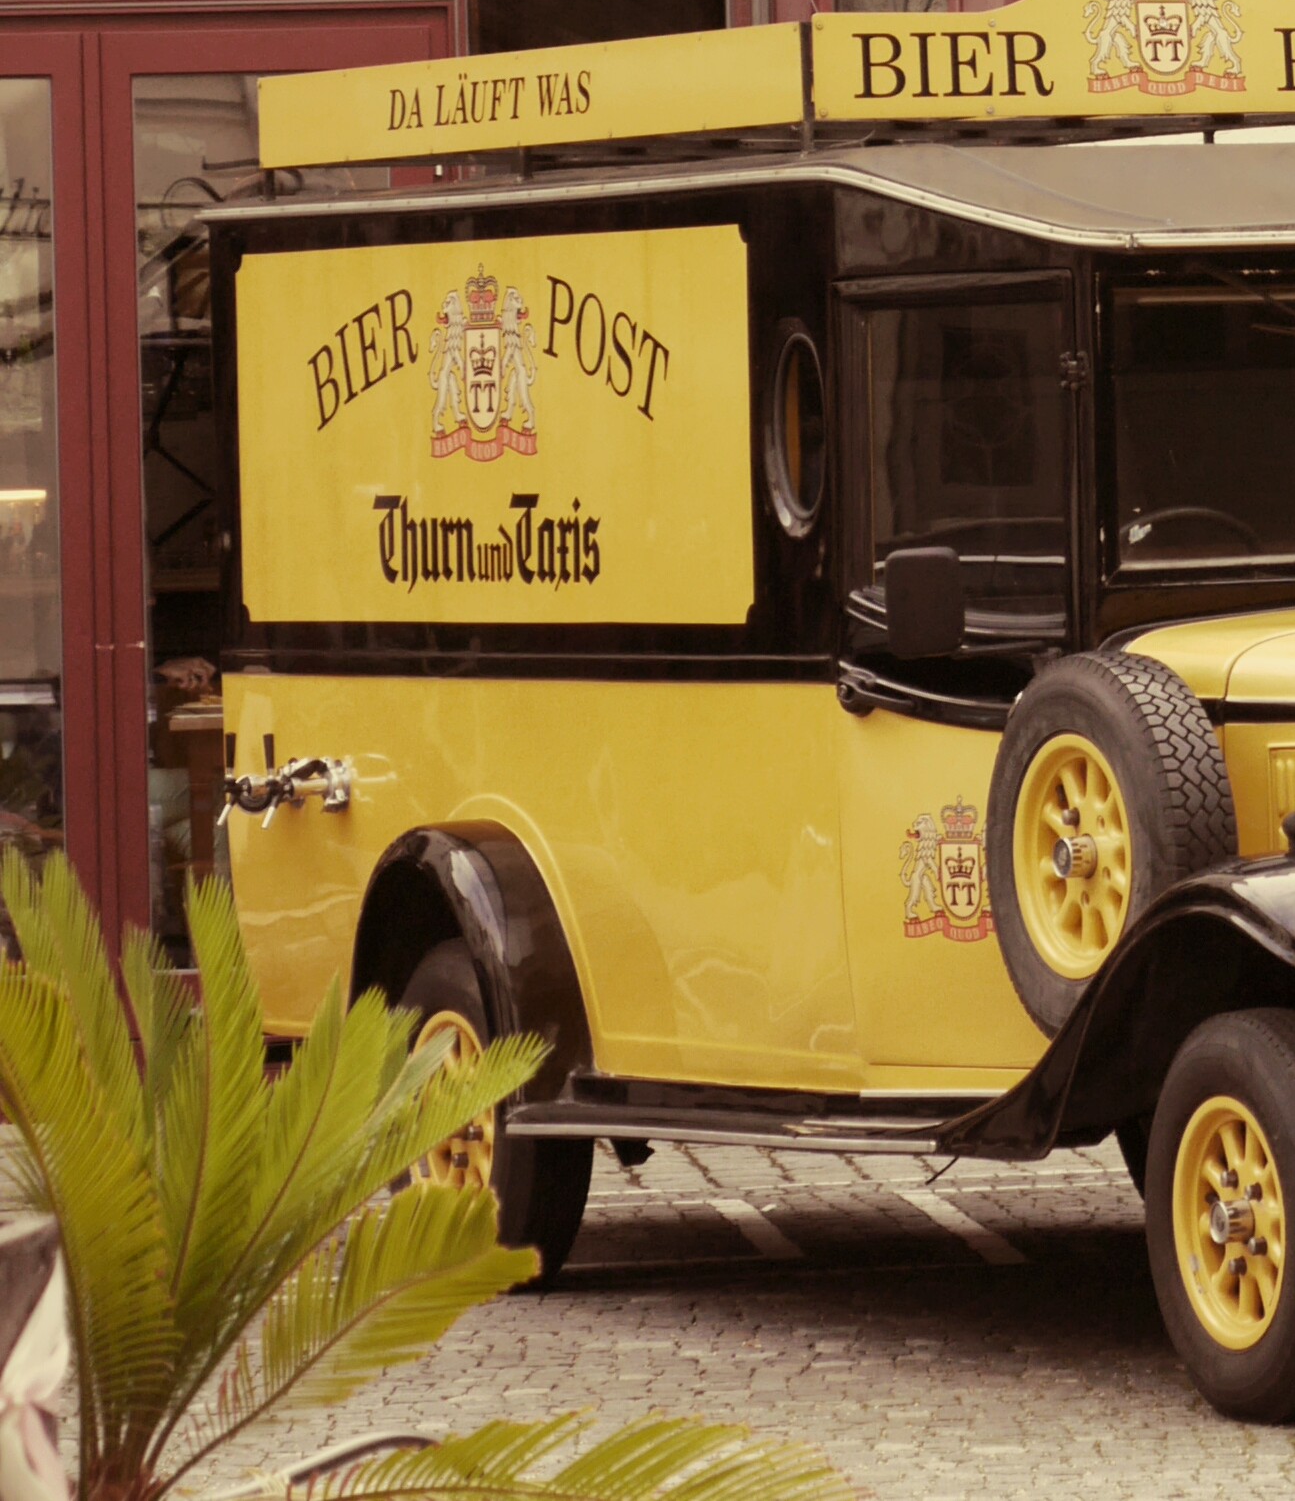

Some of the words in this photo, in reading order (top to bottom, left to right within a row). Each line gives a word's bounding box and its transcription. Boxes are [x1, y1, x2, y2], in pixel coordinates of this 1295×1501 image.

[851, 30, 1054, 99] BIER
[1145, 39, 1184, 62] TT
[387, 88, 423, 132] DA
[433, 74, 527, 127] LÄUFT
[536, 70, 592, 117] WAS
[1093, 73, 1140, 92] HABEO
[1148, 81, 1187, 94] QUOD
[1195, 73, 1239, 90] DEDI
[307, 288, 419, 431] BIER
[543, 274, 670, 422] POST
[469, 382, 496, 413] TT
[373, 494, 476, 594] Thurn
[477, 524, 513, 583] und
[509, 493, 601, 592] Taxis
[947, 882, 975, 906] TT
